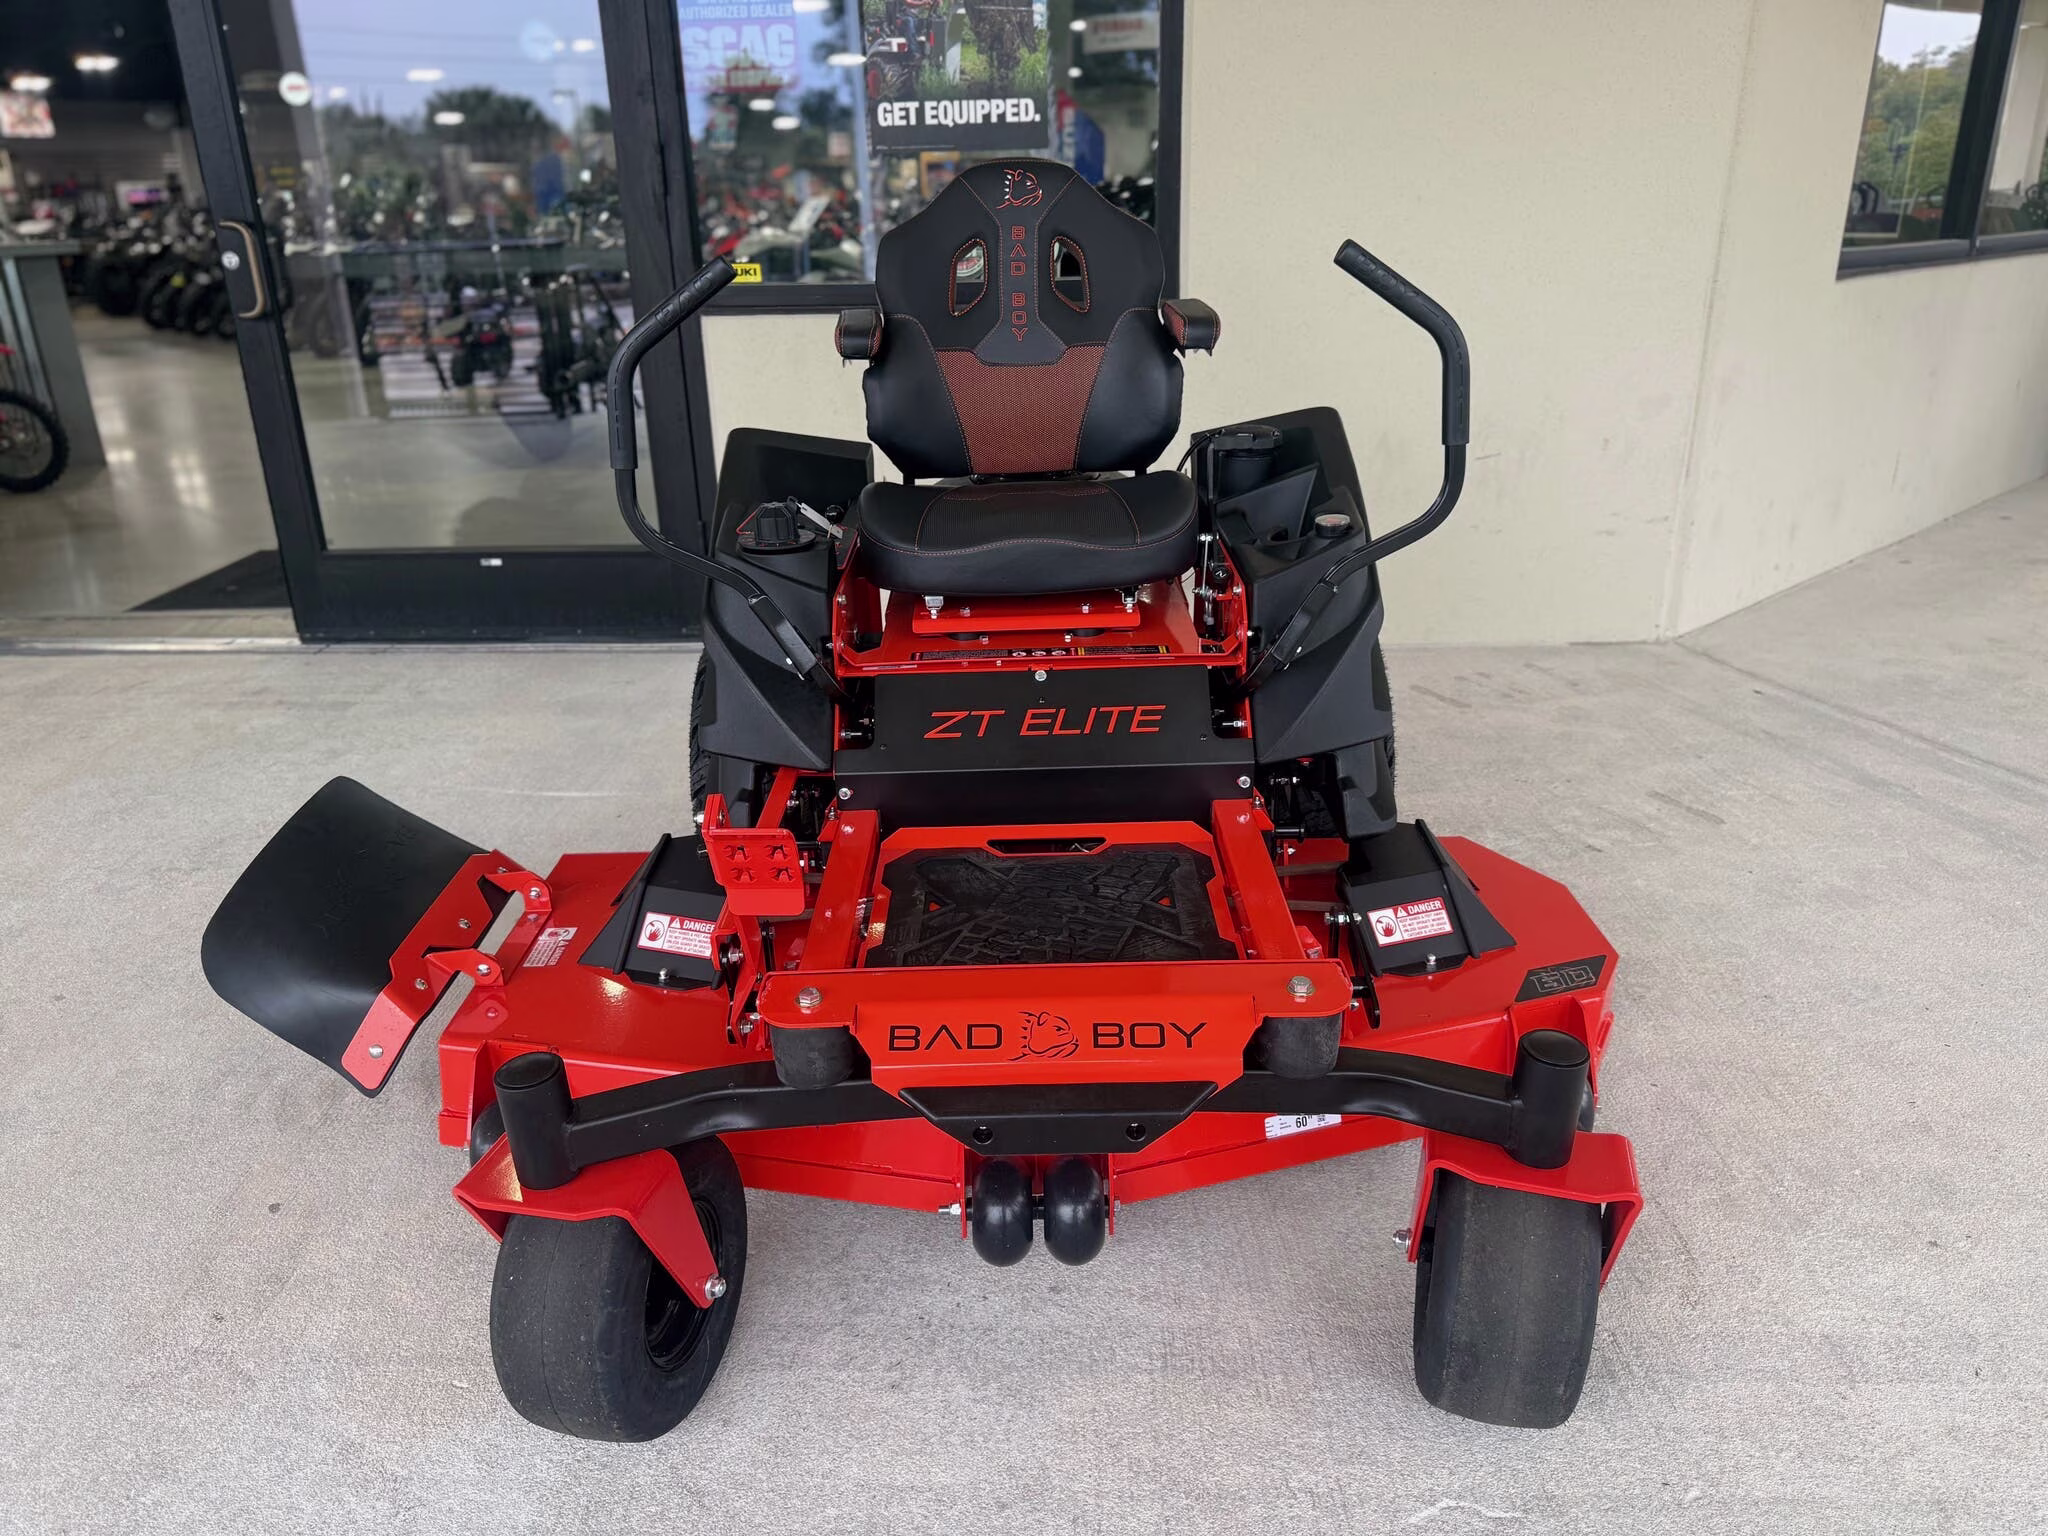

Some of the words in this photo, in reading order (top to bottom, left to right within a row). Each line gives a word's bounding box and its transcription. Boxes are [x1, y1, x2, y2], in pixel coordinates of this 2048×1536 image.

[680, 6, 748, 19] AUTHORIZED
[750, 4, 793, 17] DEALER
[877, 100, 920, 127] GET
[924, 98, 1041, 128] EQUIPPED.
[1010, 226, 1027, 276] BAD
[736, 268, 757, 277] UKI
[1011, 292, 1028, 342] BOY
[923, 709, 1005, 739] ZT
[1019, 705, 1166, 736] ELITE
[1407, 900, 1442, 914] DANGER
[888, 1023, 1003, 1052] BAD
[1092, 1021, 1208, 1049] BOY
